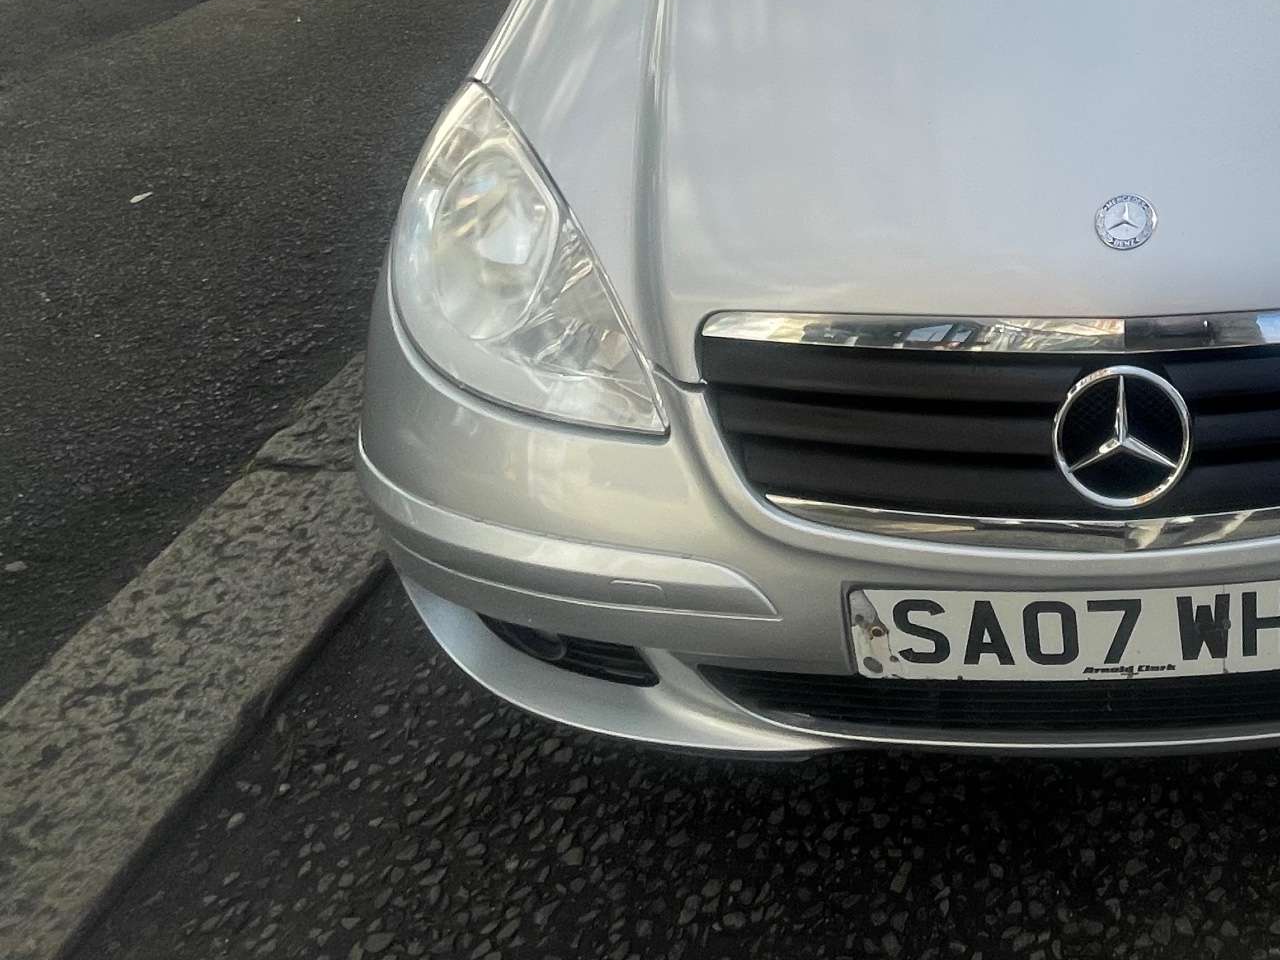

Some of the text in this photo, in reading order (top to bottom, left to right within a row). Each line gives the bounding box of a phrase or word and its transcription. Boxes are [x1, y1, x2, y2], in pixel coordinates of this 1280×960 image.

[892, 598, 1143, 666] SA07
[1082, 663, 1176, 674] Arnold Clark
